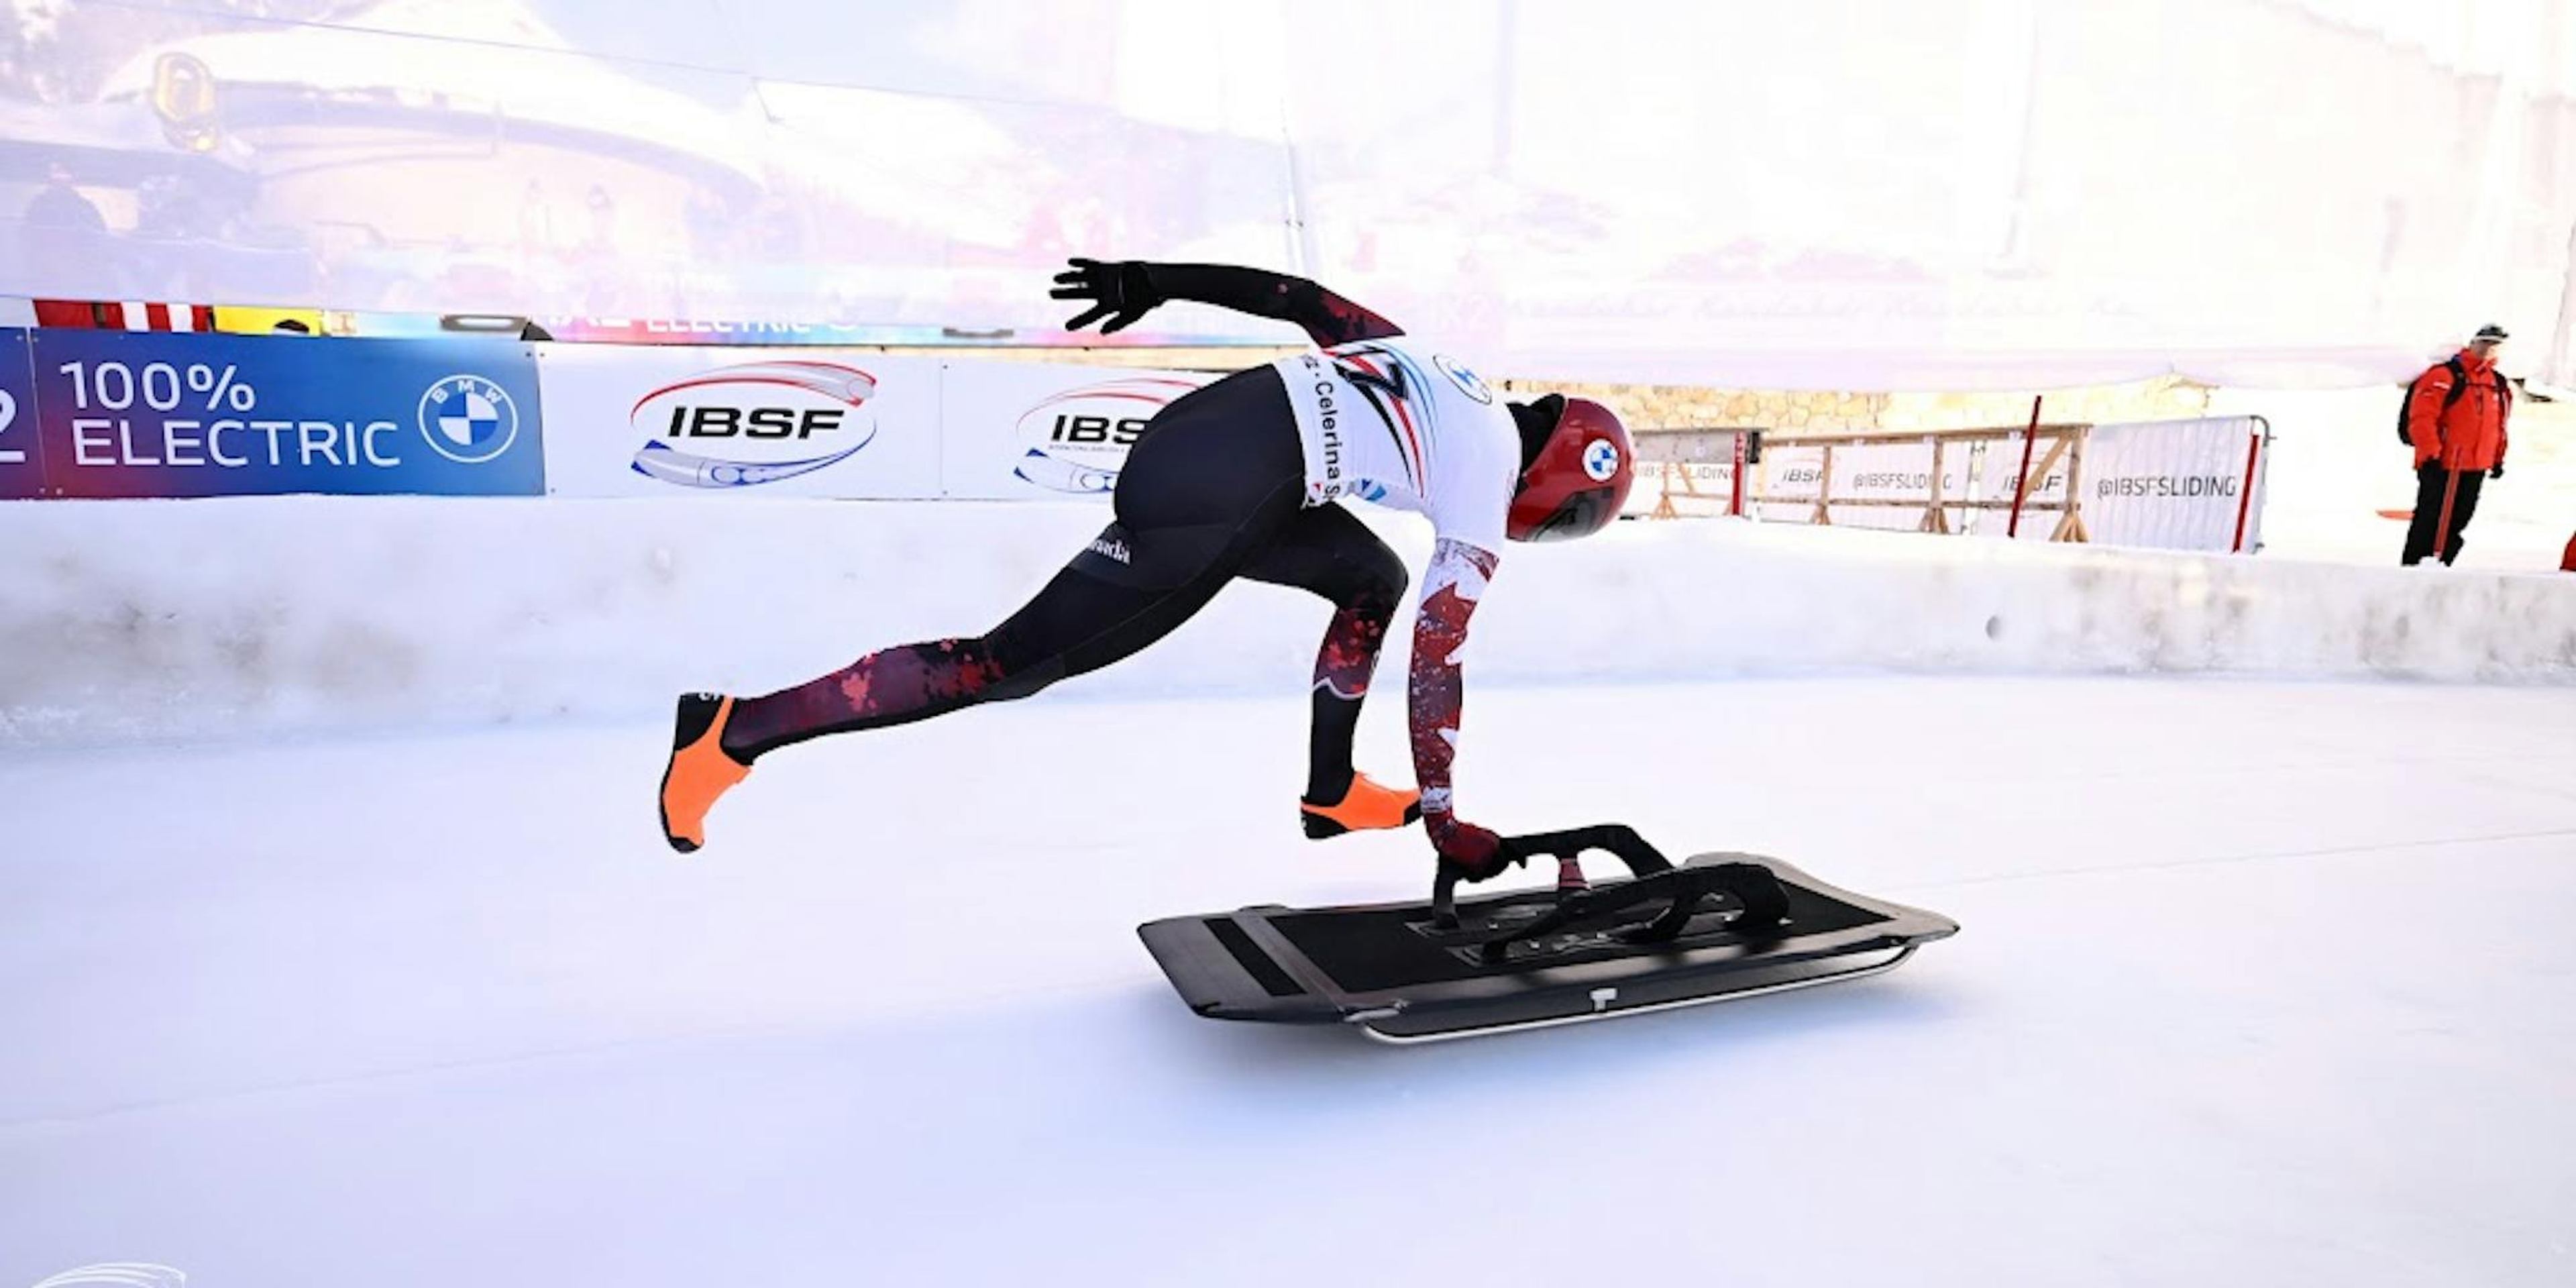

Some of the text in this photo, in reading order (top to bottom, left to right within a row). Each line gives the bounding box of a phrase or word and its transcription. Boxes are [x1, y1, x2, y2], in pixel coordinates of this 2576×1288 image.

[60, 361, 255, 411] 100%
[431, 380, 503, 404] BMW
[668, 407, 845, 439] IBSF
[1051, 415, 1151, 443] IBS
[1316, 381, 1342, 479] Celerina
[72, 419, 400, 466] ELECTRIC
[2097, 476, 2237, 500] @IBSFSLIDING
